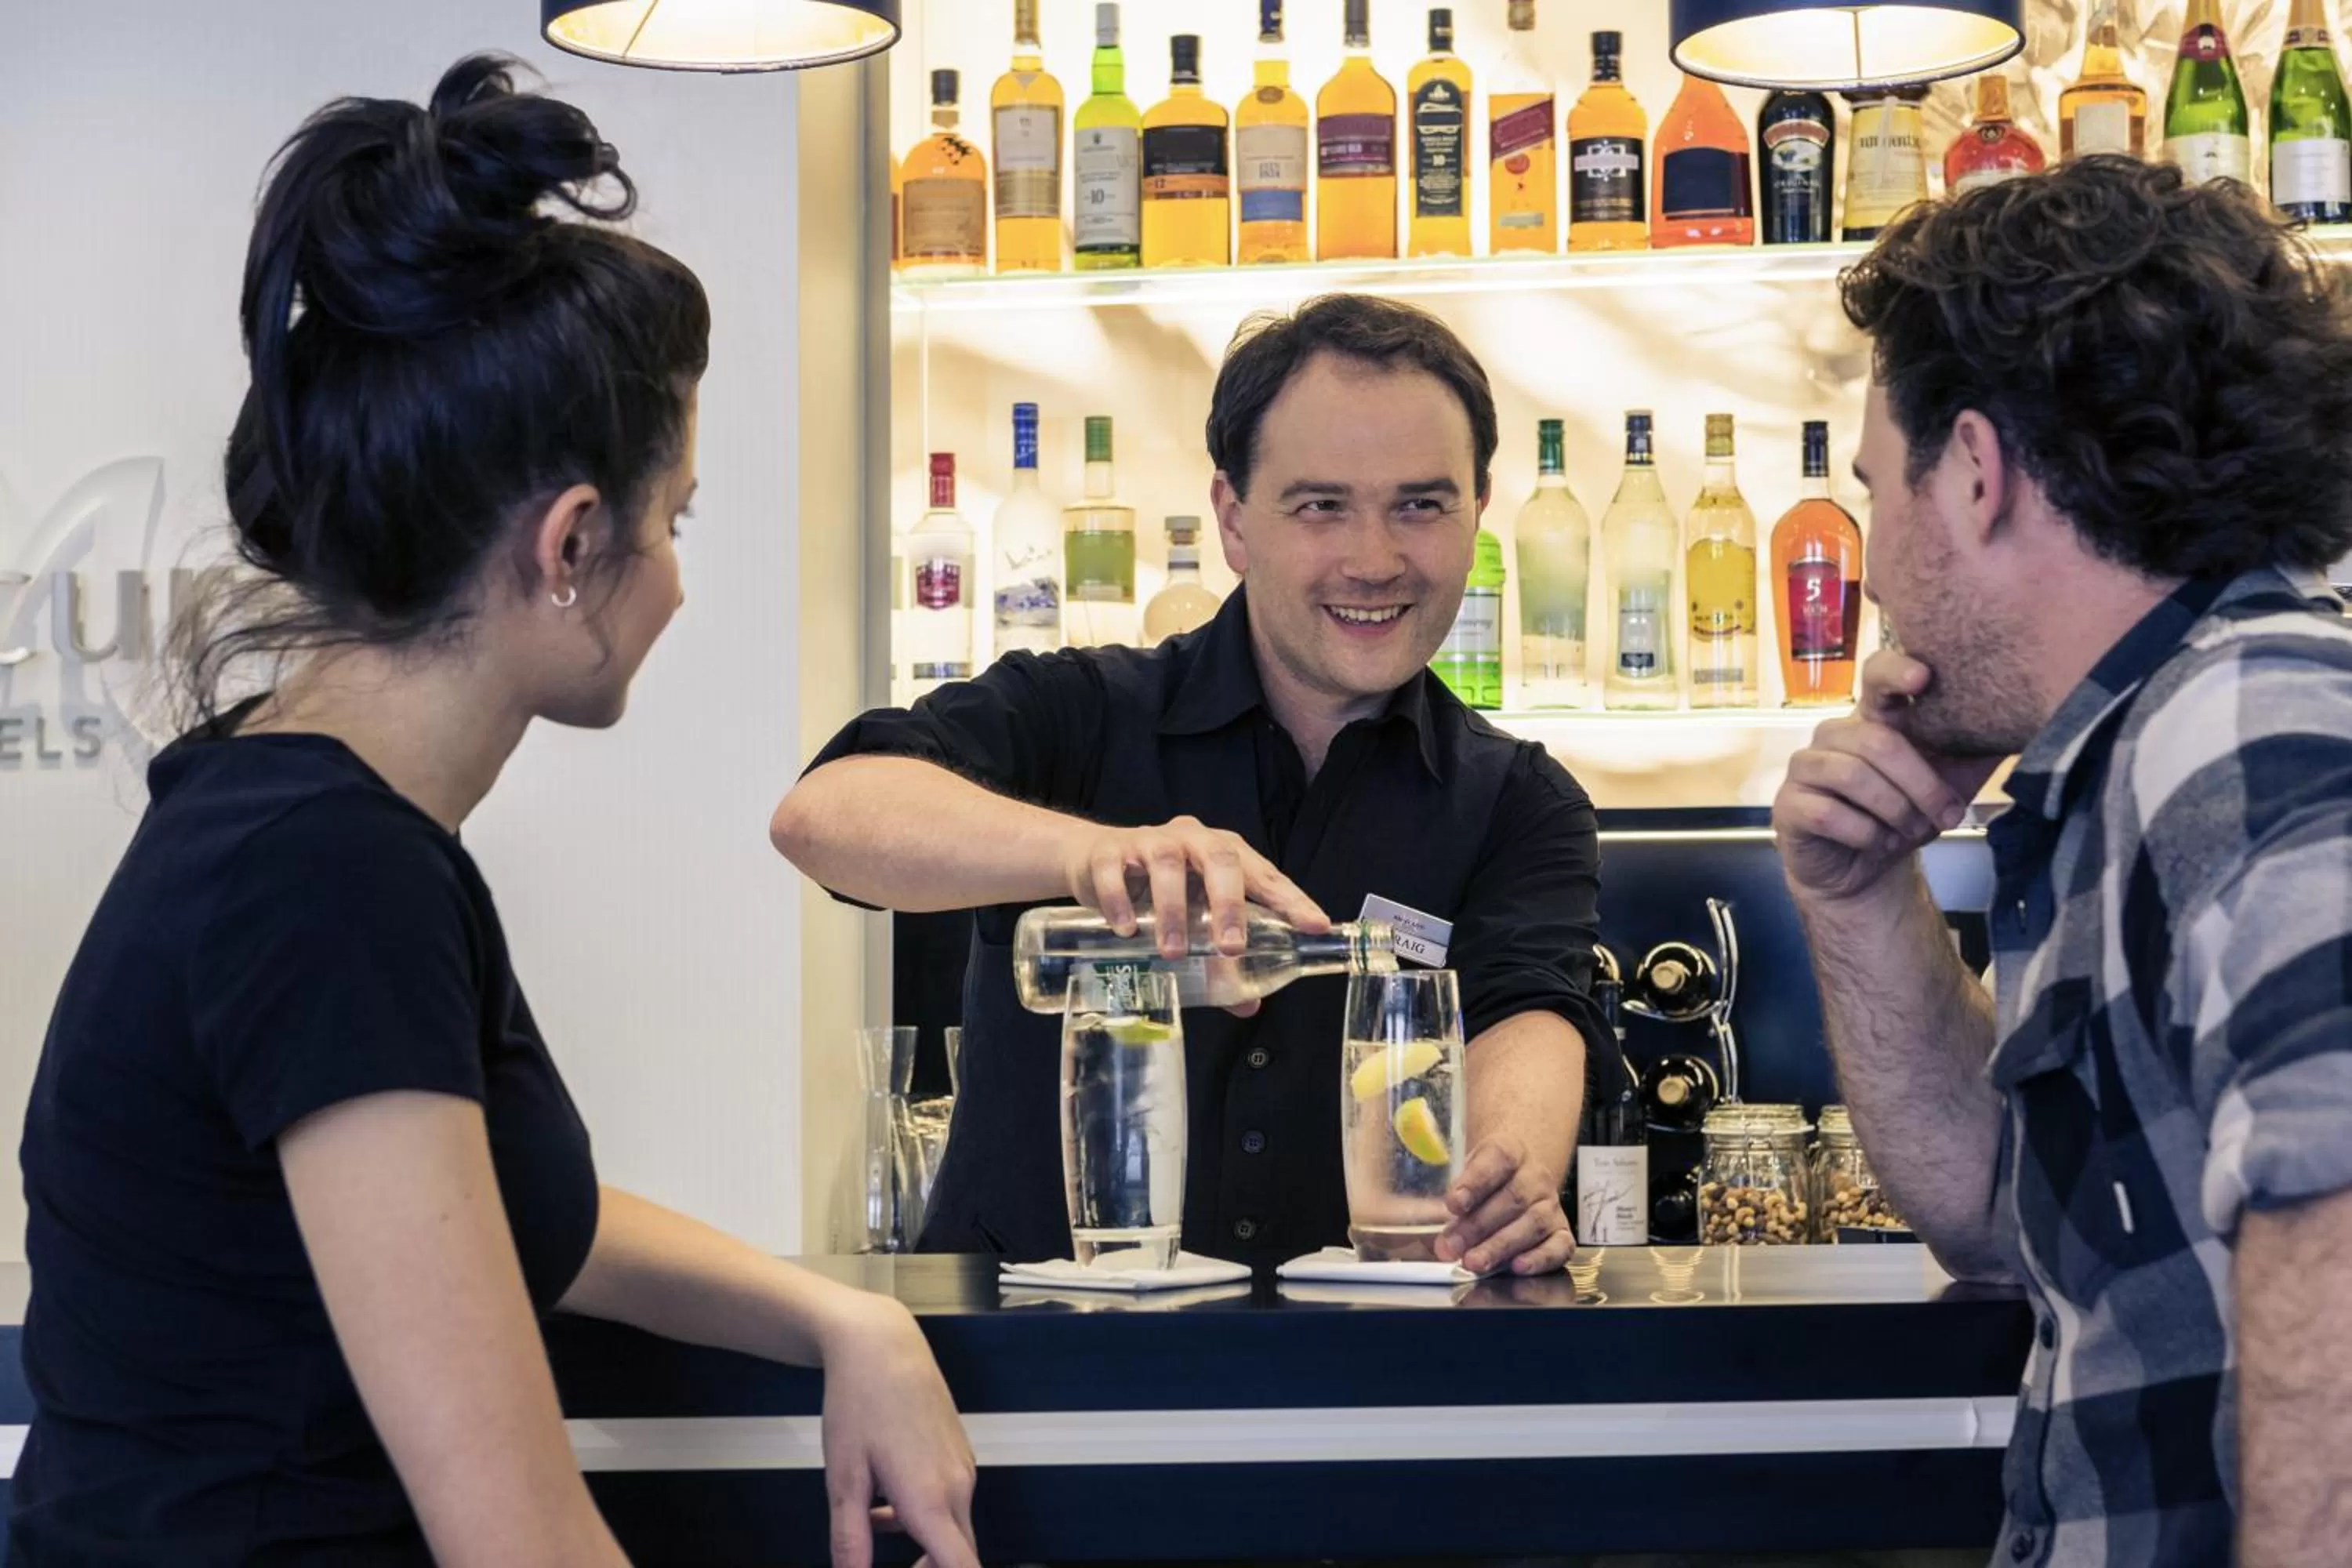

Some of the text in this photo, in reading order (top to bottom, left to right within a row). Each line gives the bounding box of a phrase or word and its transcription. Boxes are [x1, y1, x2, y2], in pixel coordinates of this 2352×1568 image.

[1432, 154, 1446, 166] 10
[1091, 188, 1104, 204] 10
[1806, 579, 1821, 601] 5
[1395, 934, 1425, 954] RAIG
